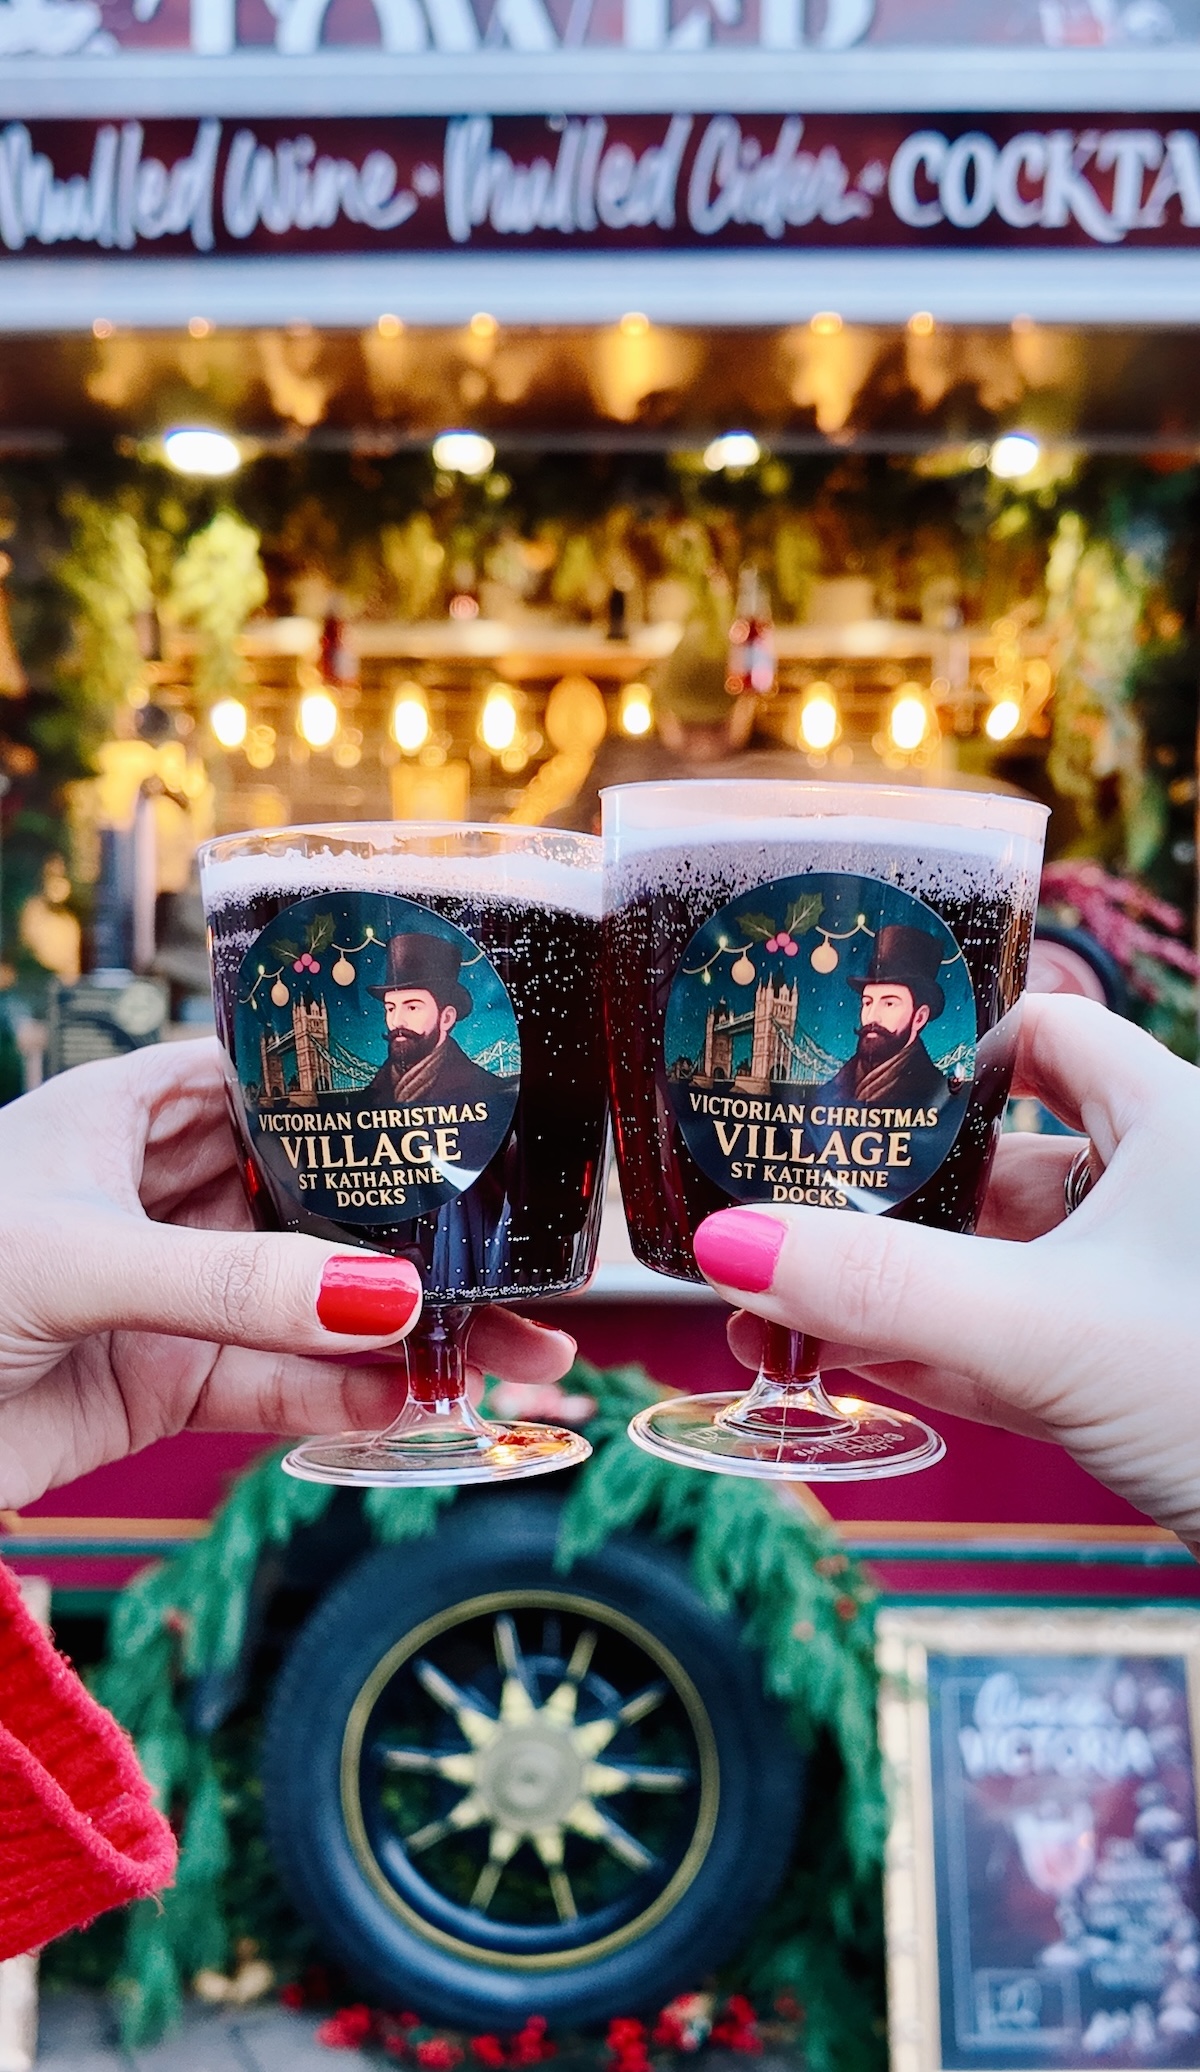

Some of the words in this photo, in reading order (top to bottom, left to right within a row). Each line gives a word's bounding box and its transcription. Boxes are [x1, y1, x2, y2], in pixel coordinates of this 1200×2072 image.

[223, 129, 418, 239] Wine
[444, 114, 694, 243] Mulled
[688, 114, 872, 239] Cider
[888, 129, 1200, 243] COCKTA
[259, 1112, 352, 1132] VICTORIAN
[357, 1102, 488, 1130] CHRISTMAS
[690, 1093, 804, 1124] VICTORIAN
[810, 1105, 938, 1127] CHRISTMAS
[280, 1127, 462, 1169] VILLAGE
[713, 1120, 912, 1167] VILLAGE
[299, 1172, 317, 1190] ST
[325, 1167, 444, 1189] KATHARINE
[731, 1161, 755, 1179] ST
[763, 1164, 889, 1187] KATHARINE
[337, 1188, 406, 1207] DOCKS
[772, 1184, 847, 1207] DOCKS
